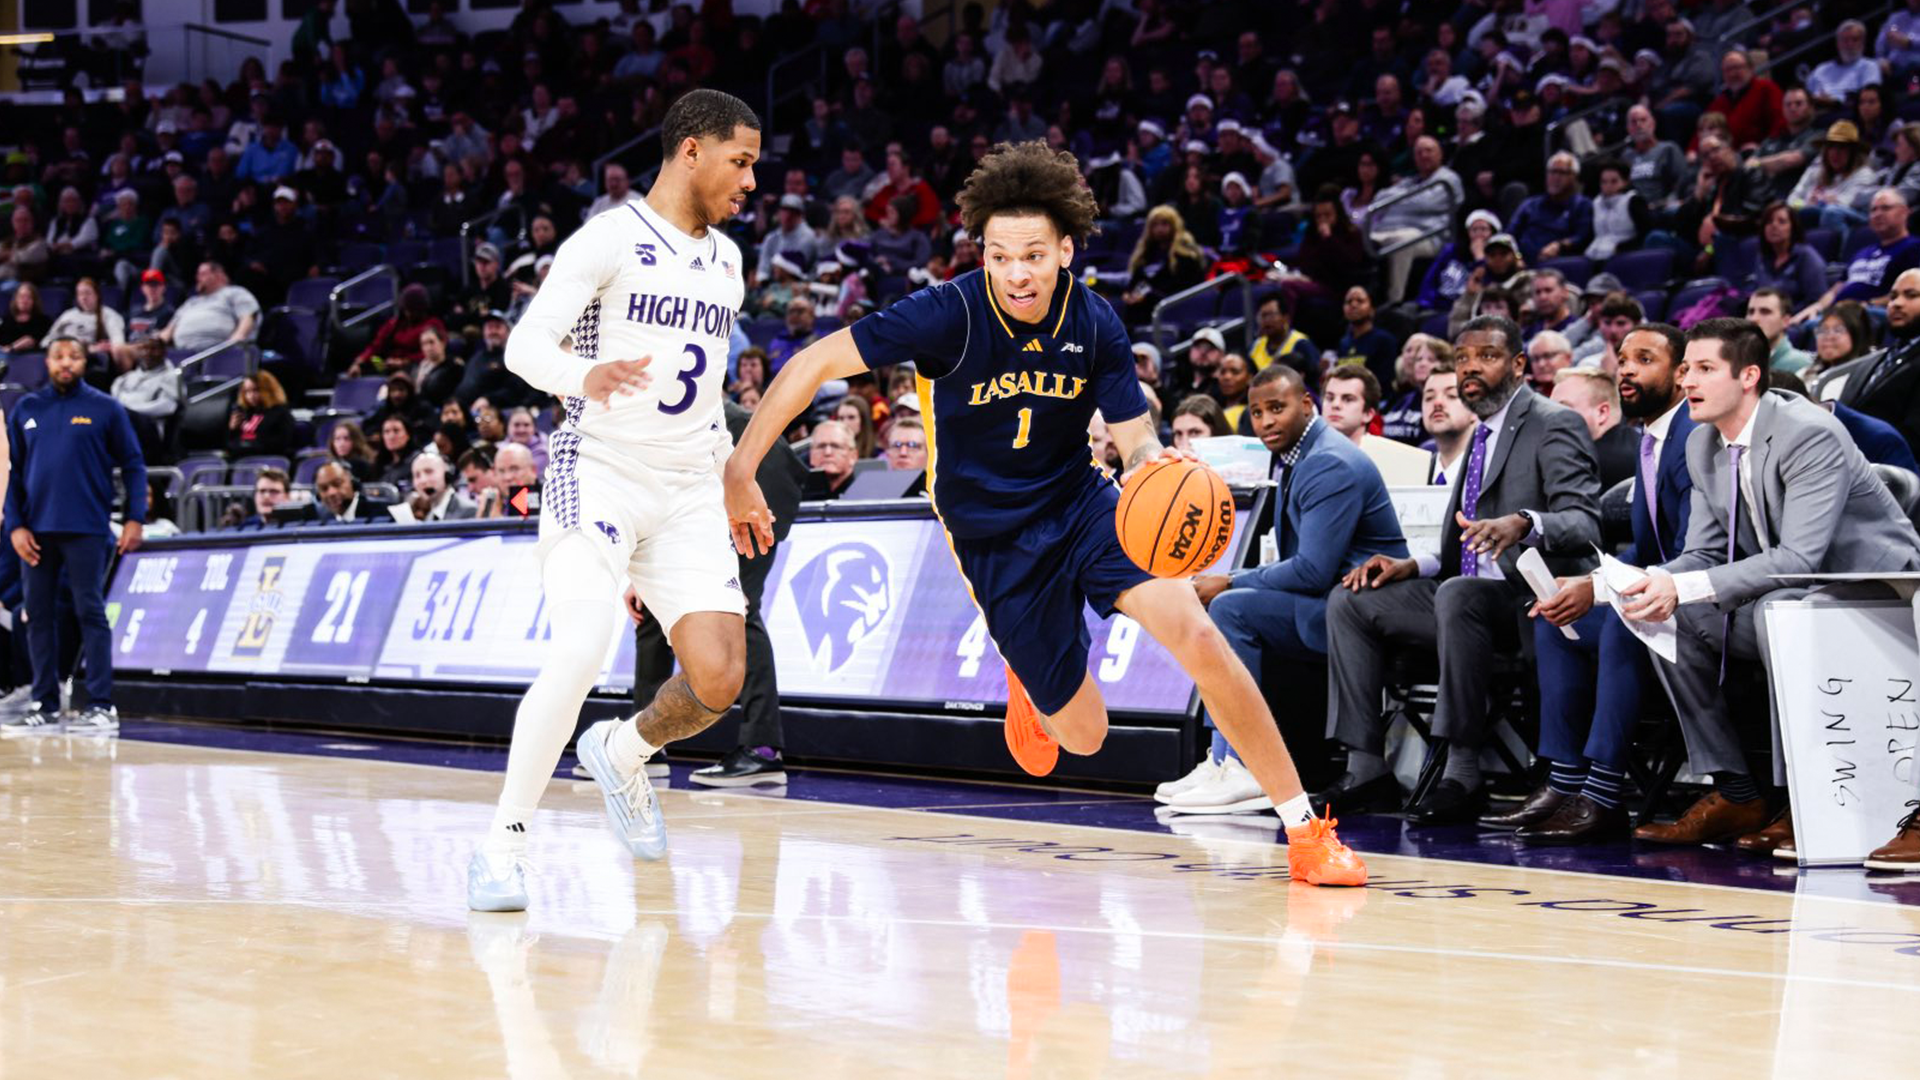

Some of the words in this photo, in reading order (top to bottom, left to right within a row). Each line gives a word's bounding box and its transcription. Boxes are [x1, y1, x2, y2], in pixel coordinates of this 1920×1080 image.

[626, 293, 689, 329] HIGH
[691, 300, 739, 339] POIN
[657, 343, 707, 415] 3
[1012, 407, 1033, 449] 1
[1167, 503, 1204, 560] NCAA
[120, 608, 145, 653] 5
[184, 608, 208, 654] 4
[311, 570, 371, 643] 21
[412, 569, 494, 641] 3:11
[956, 612, 988, 678] 4
[1098, 613, 1141, 683] 9
[1818, 678, 1860, 806] SWING
